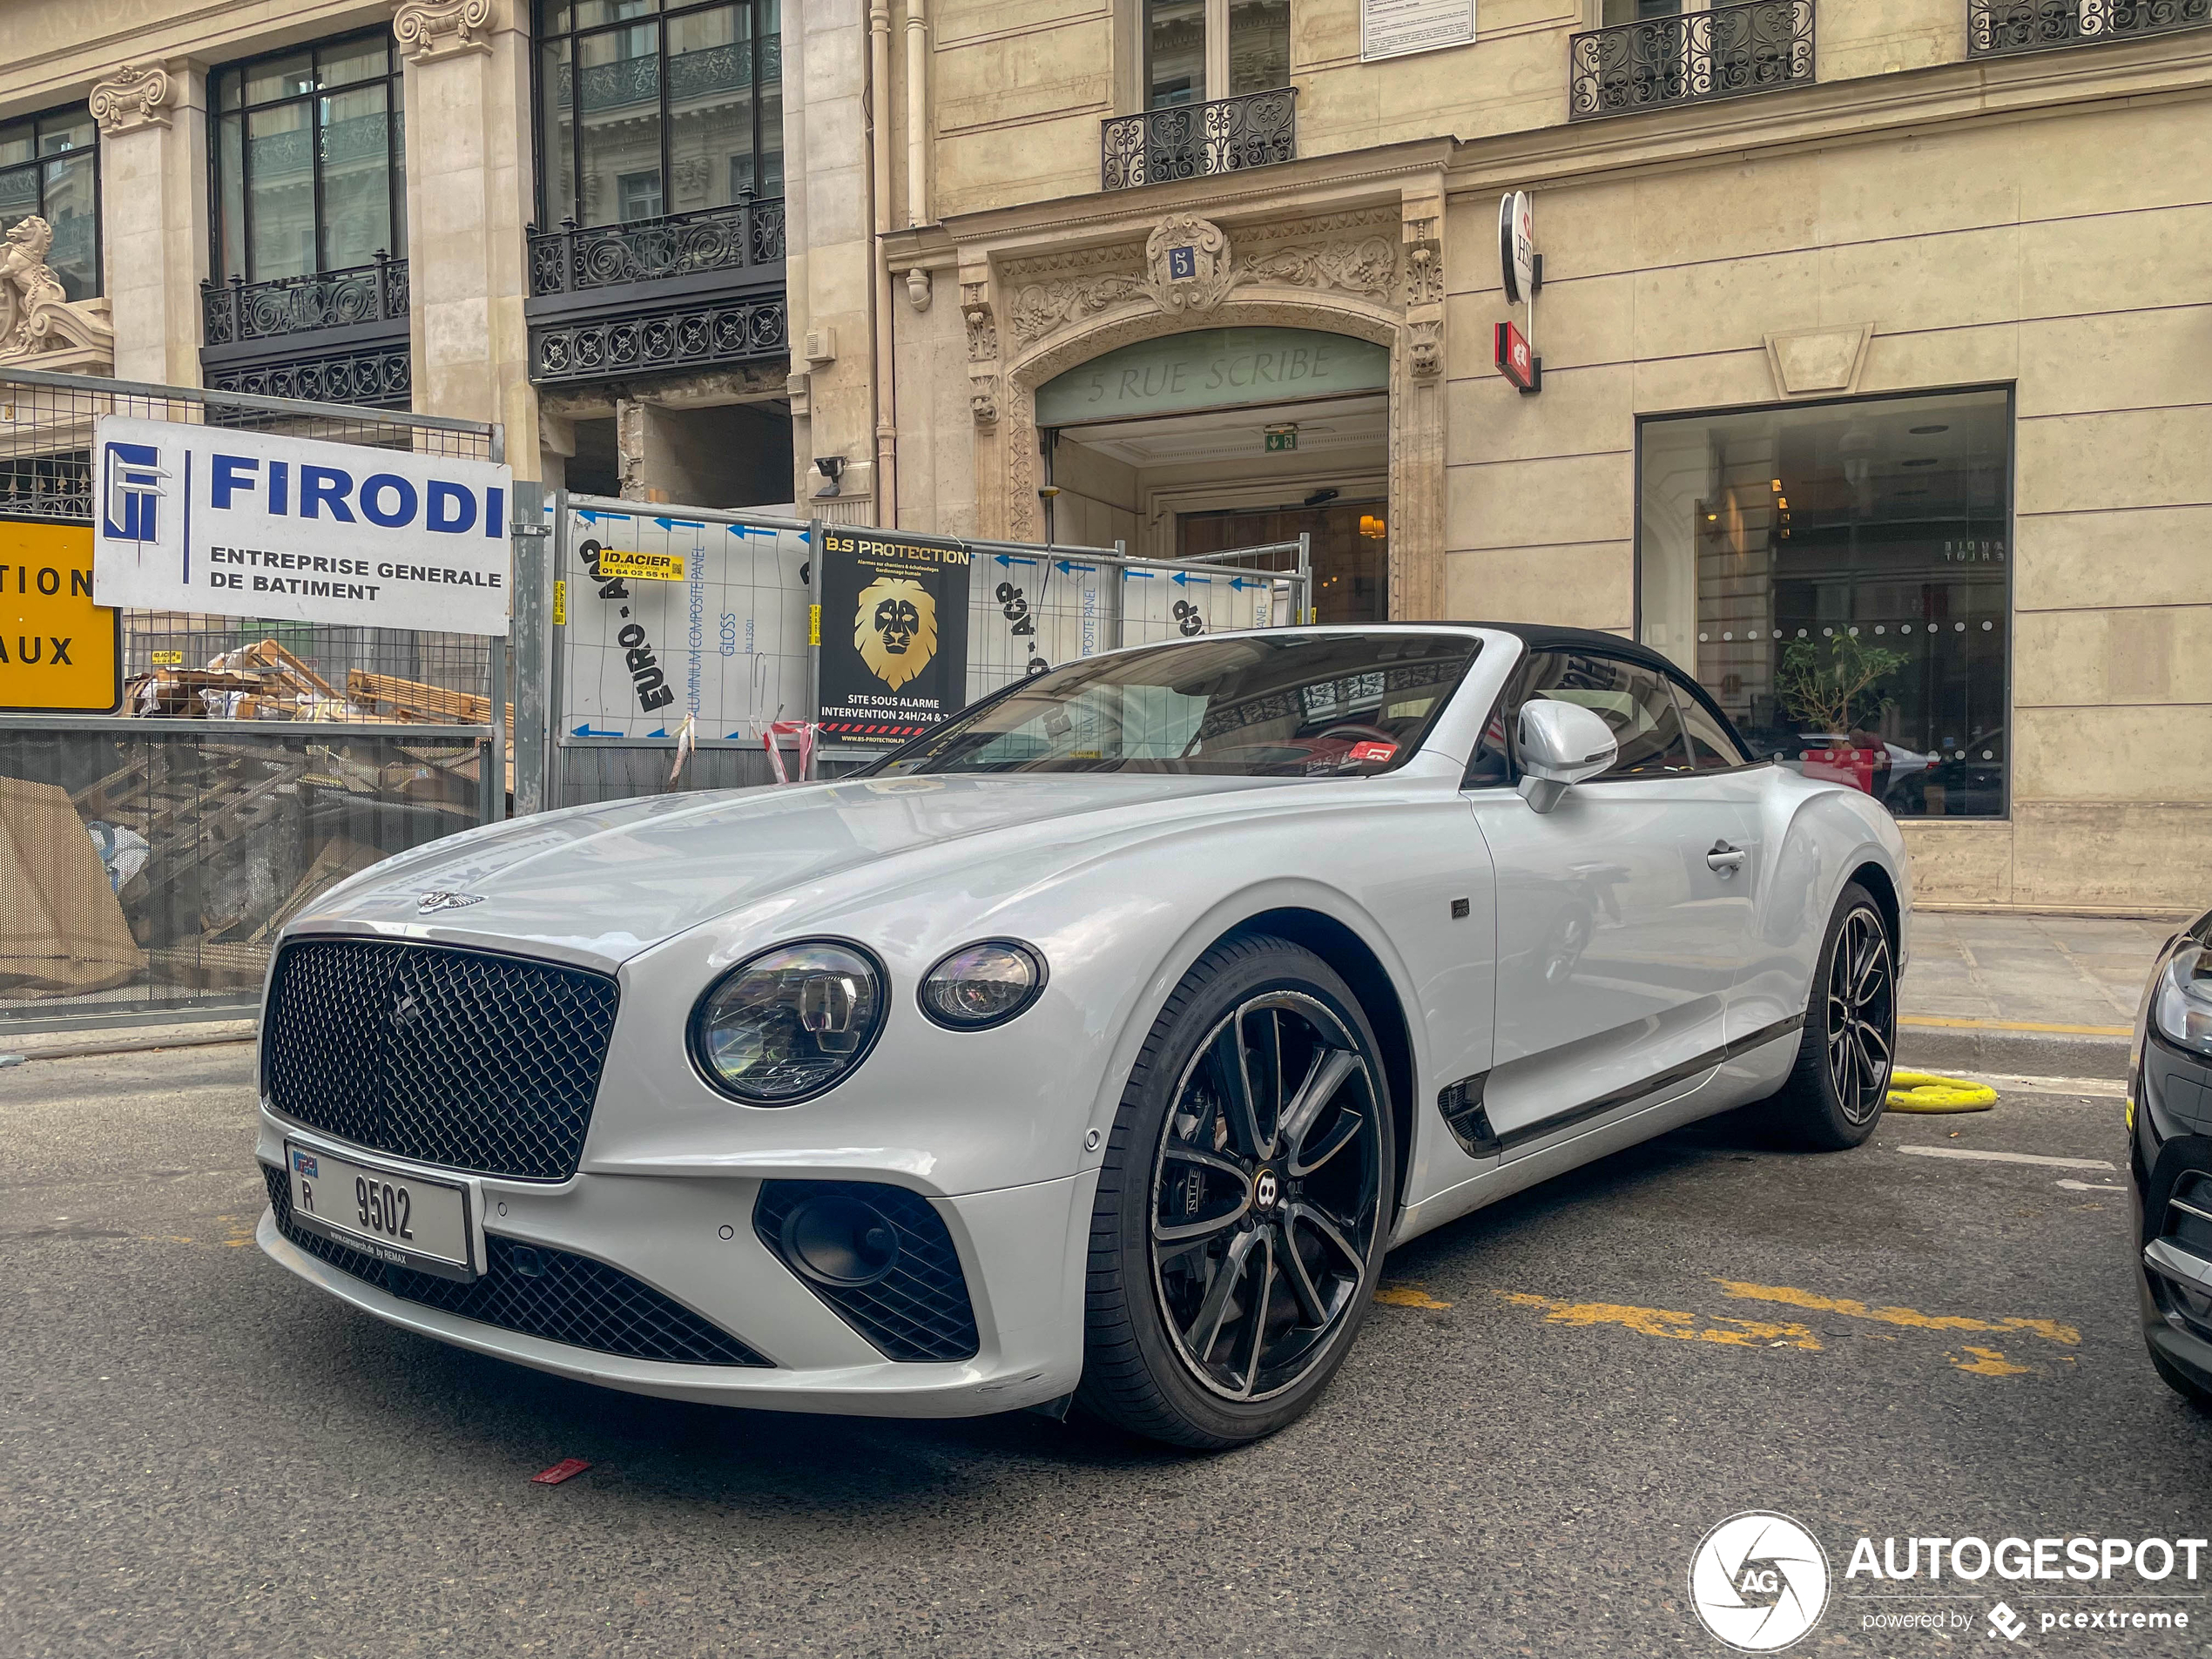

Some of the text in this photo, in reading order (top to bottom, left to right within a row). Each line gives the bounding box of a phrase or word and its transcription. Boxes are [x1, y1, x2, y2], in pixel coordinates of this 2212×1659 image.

[1175, 252, 1188, 274] 5
[1088, 345, 1332, 402] 5 RUE SCRIBE
[212, 453, 504, 539] FIRODI
[211, 546, 502, 589] ENTREPRISE GENERALE
[604, 552, 671, 567] ID.ACIER
[858, 540, 969, 565] PROTECTION
[210, 571, 381, 601] DE BATIMENT
[1084, 588, 1096, 618] PANEL
[1257, 604, 1267, 629] ANEL
[687, 545, 705, 719] ALUMINIUM COMPOSITE PANEL
[719, 612, 736, 657] GLOSS
[821, 706, 896, 720] INTERVENTION
[898, 711, 933, 722] 24H/24
[934, 713, 941, 723] &
[847, 693, 940, 709] SITE SOUS ALARME
[841, 735, 906, 744] WWW.BS-PROTECTION.FR
[1188, 1168, 1199, 1211] NTLE
[301, 1174, 415, 1240] R 9502
[330, 1231, 407, 1264] www.carsearch.de by REMAX
